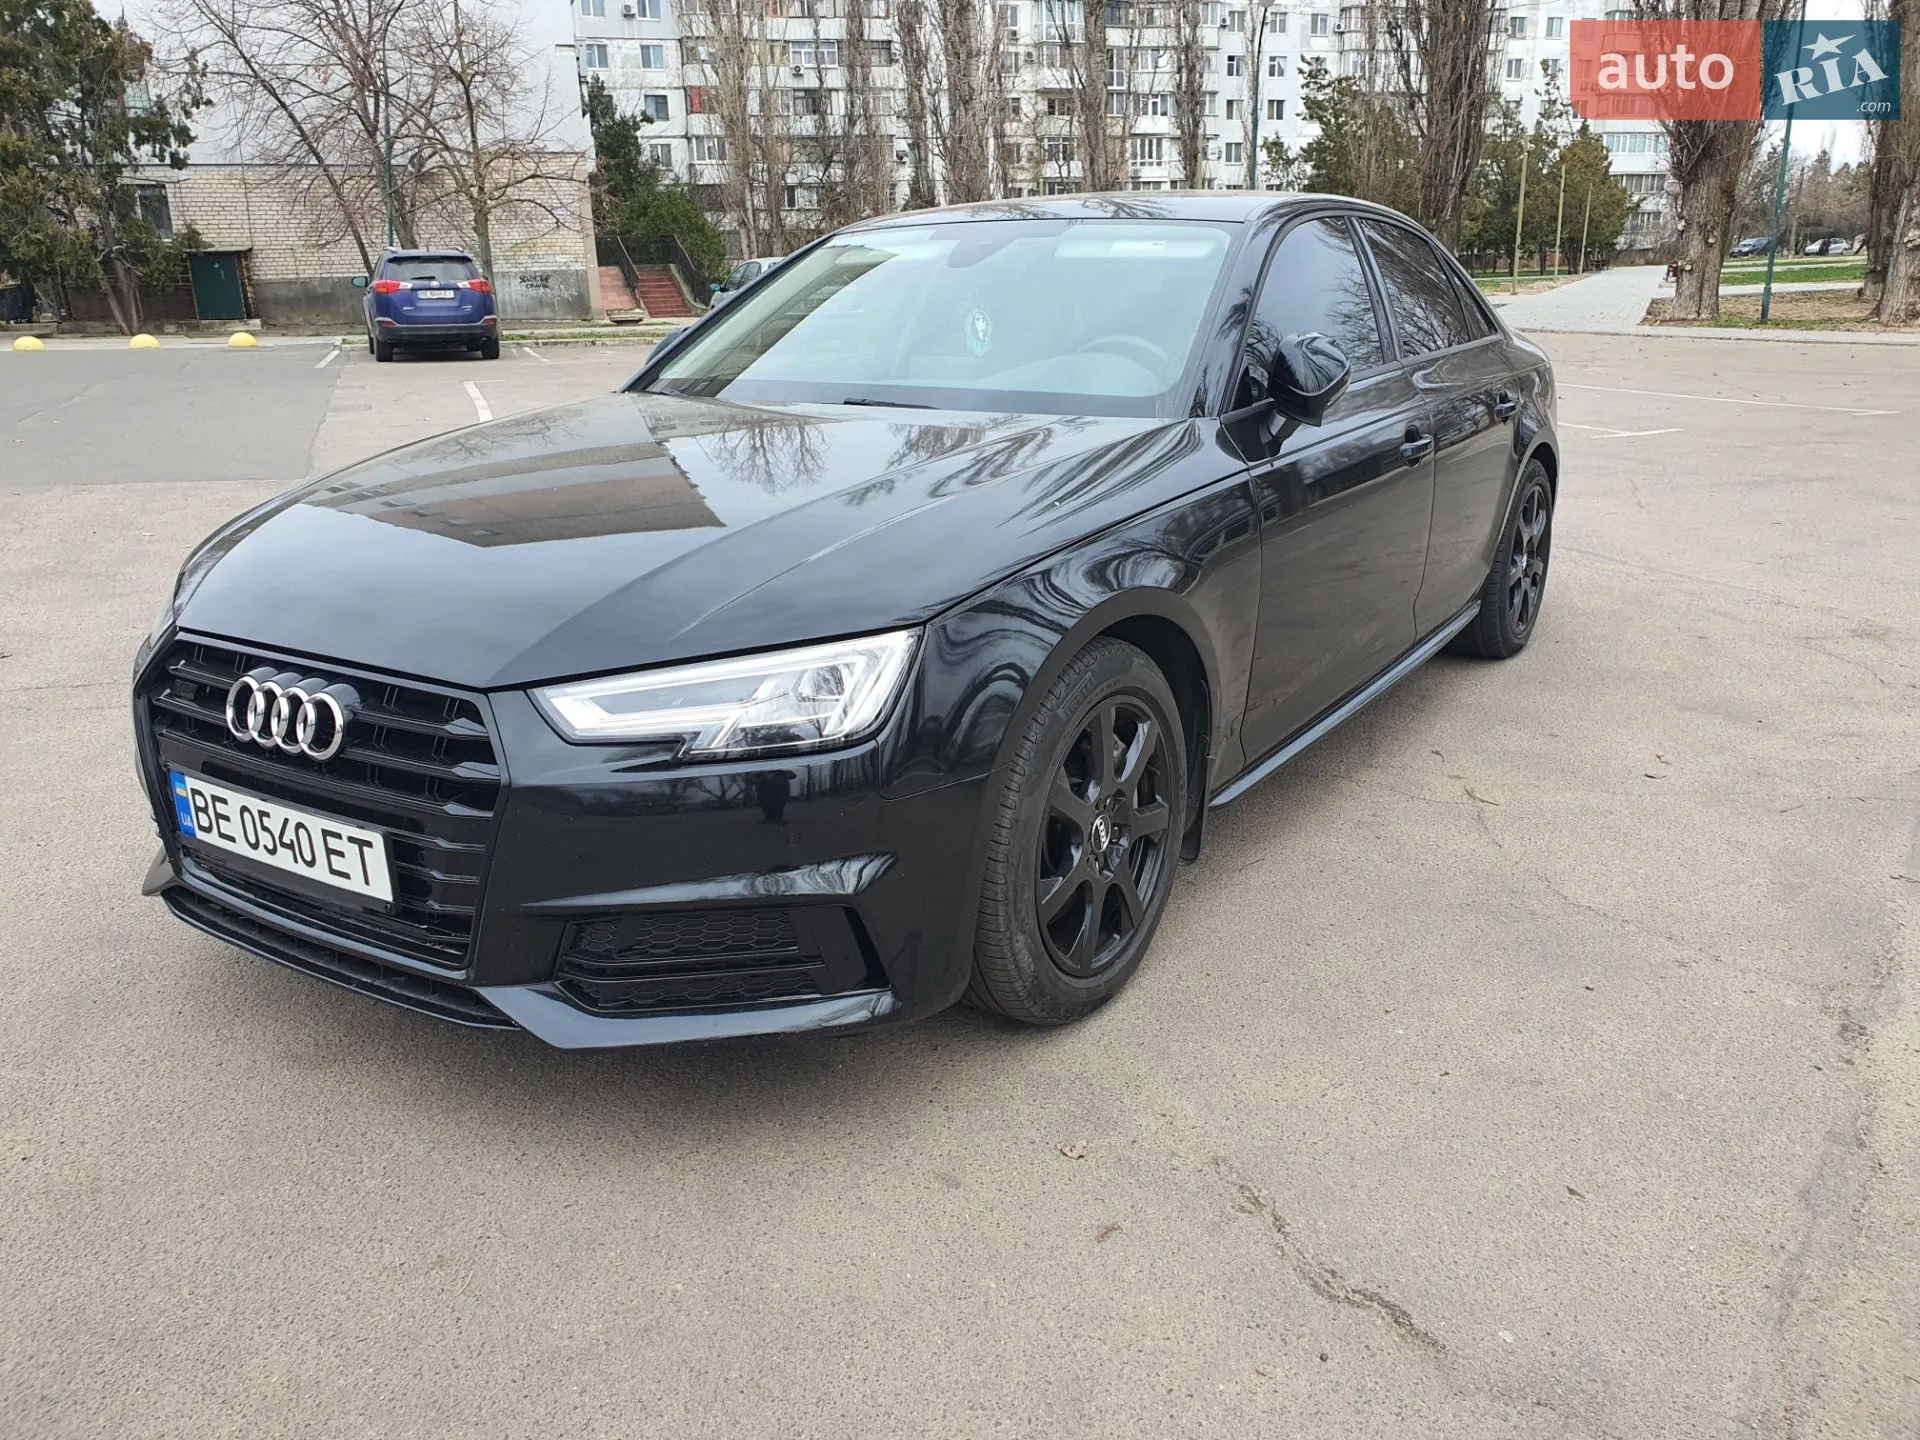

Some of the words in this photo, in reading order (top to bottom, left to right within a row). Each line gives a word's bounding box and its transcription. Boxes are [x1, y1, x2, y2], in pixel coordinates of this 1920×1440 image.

[181, 812, 193, 828] UA
[190, 787, 236, 843] BE
[239, 804, 317, 868] 0540
[321, 828, 374, 886] ET
